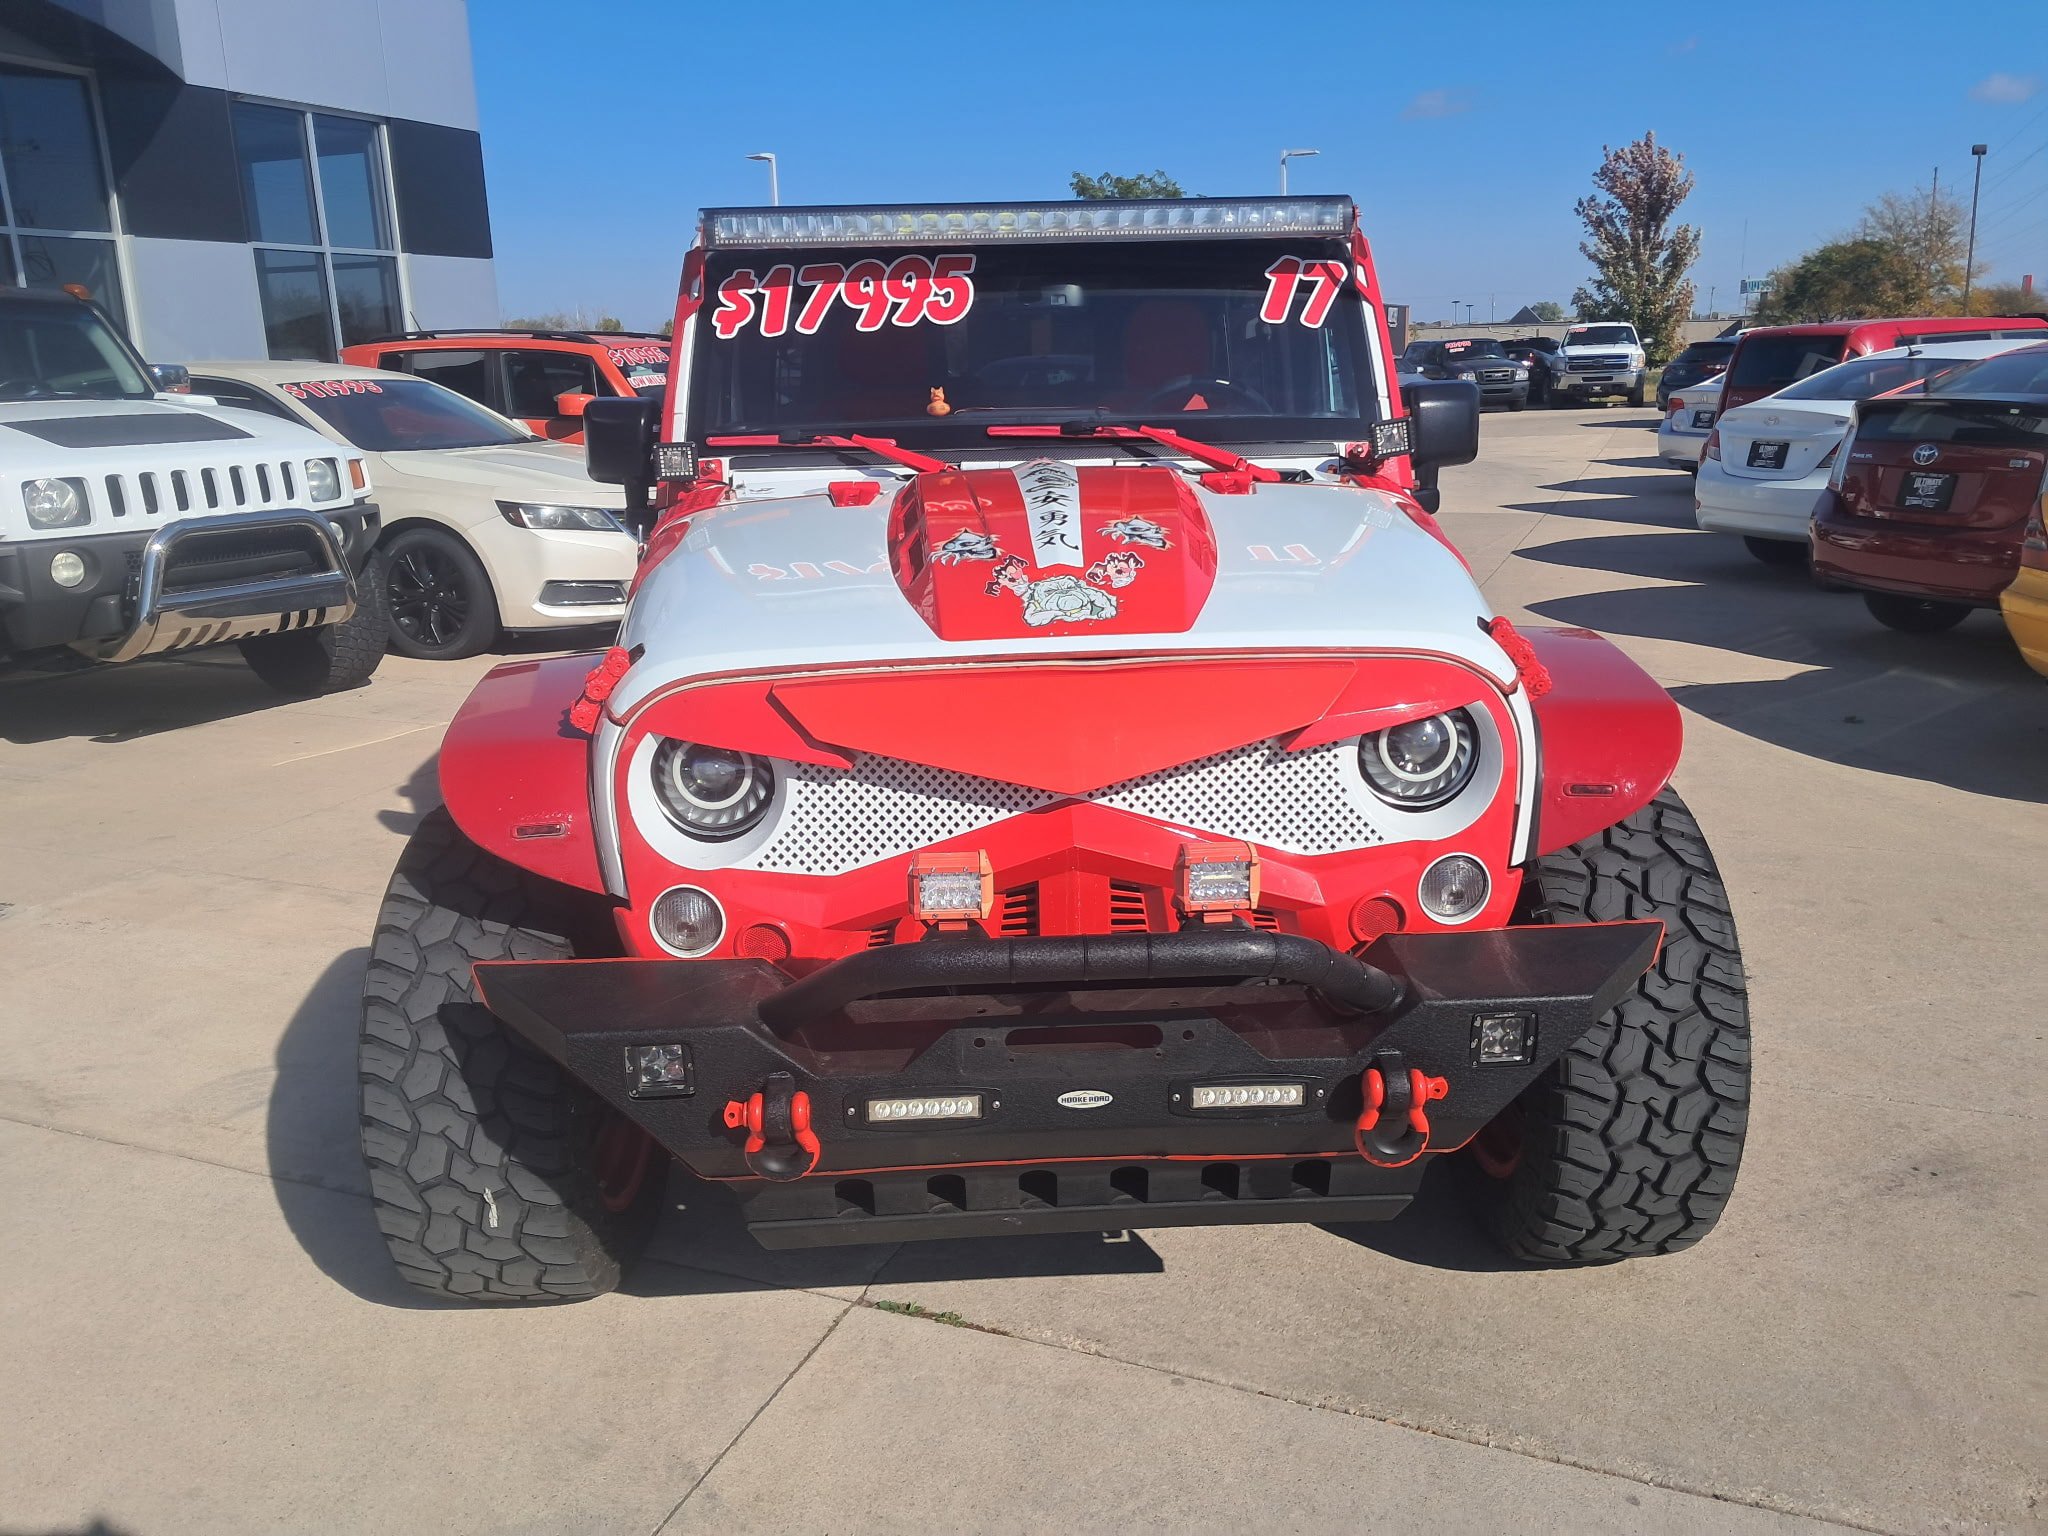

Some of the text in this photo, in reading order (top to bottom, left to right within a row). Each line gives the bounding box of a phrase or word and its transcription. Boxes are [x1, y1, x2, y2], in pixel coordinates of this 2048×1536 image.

[711, 253, 977, 340] $17995
[1260, 254, 1348, 329] 17
[608, 347, 670, 366] $10995
[283, 380, 383, 399] $11995
